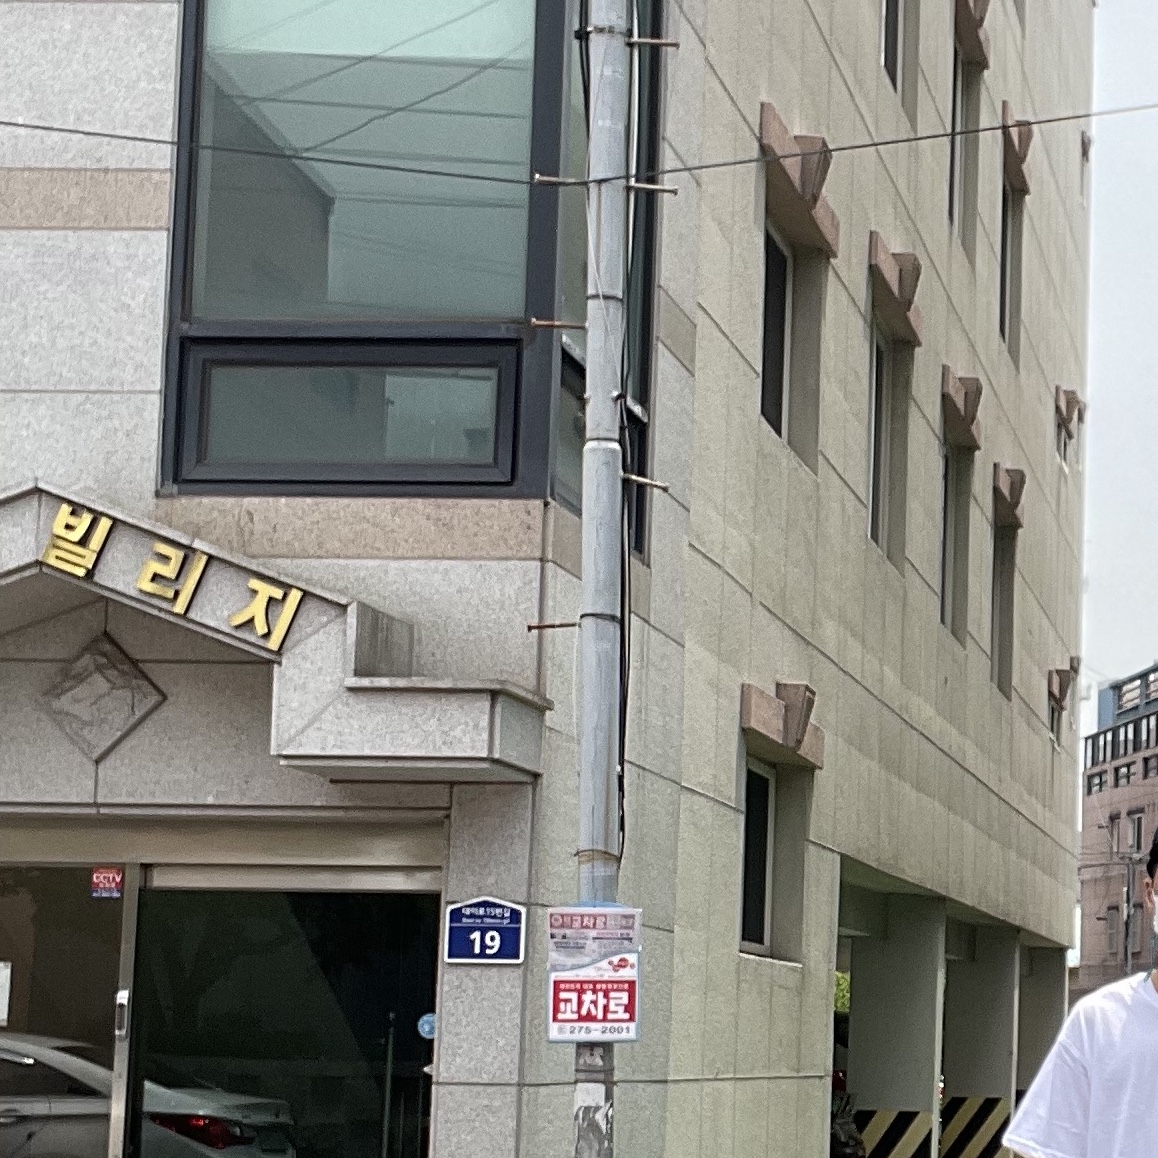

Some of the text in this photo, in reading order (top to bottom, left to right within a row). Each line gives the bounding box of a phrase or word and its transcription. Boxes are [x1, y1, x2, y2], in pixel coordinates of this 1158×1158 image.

[42, 503, 304, 651] 빌리지
[469, 930, 501, 955] 19
[557, 990, 630, 1020] 교차로
[569, 1025, 631, 1035] 275-2001
